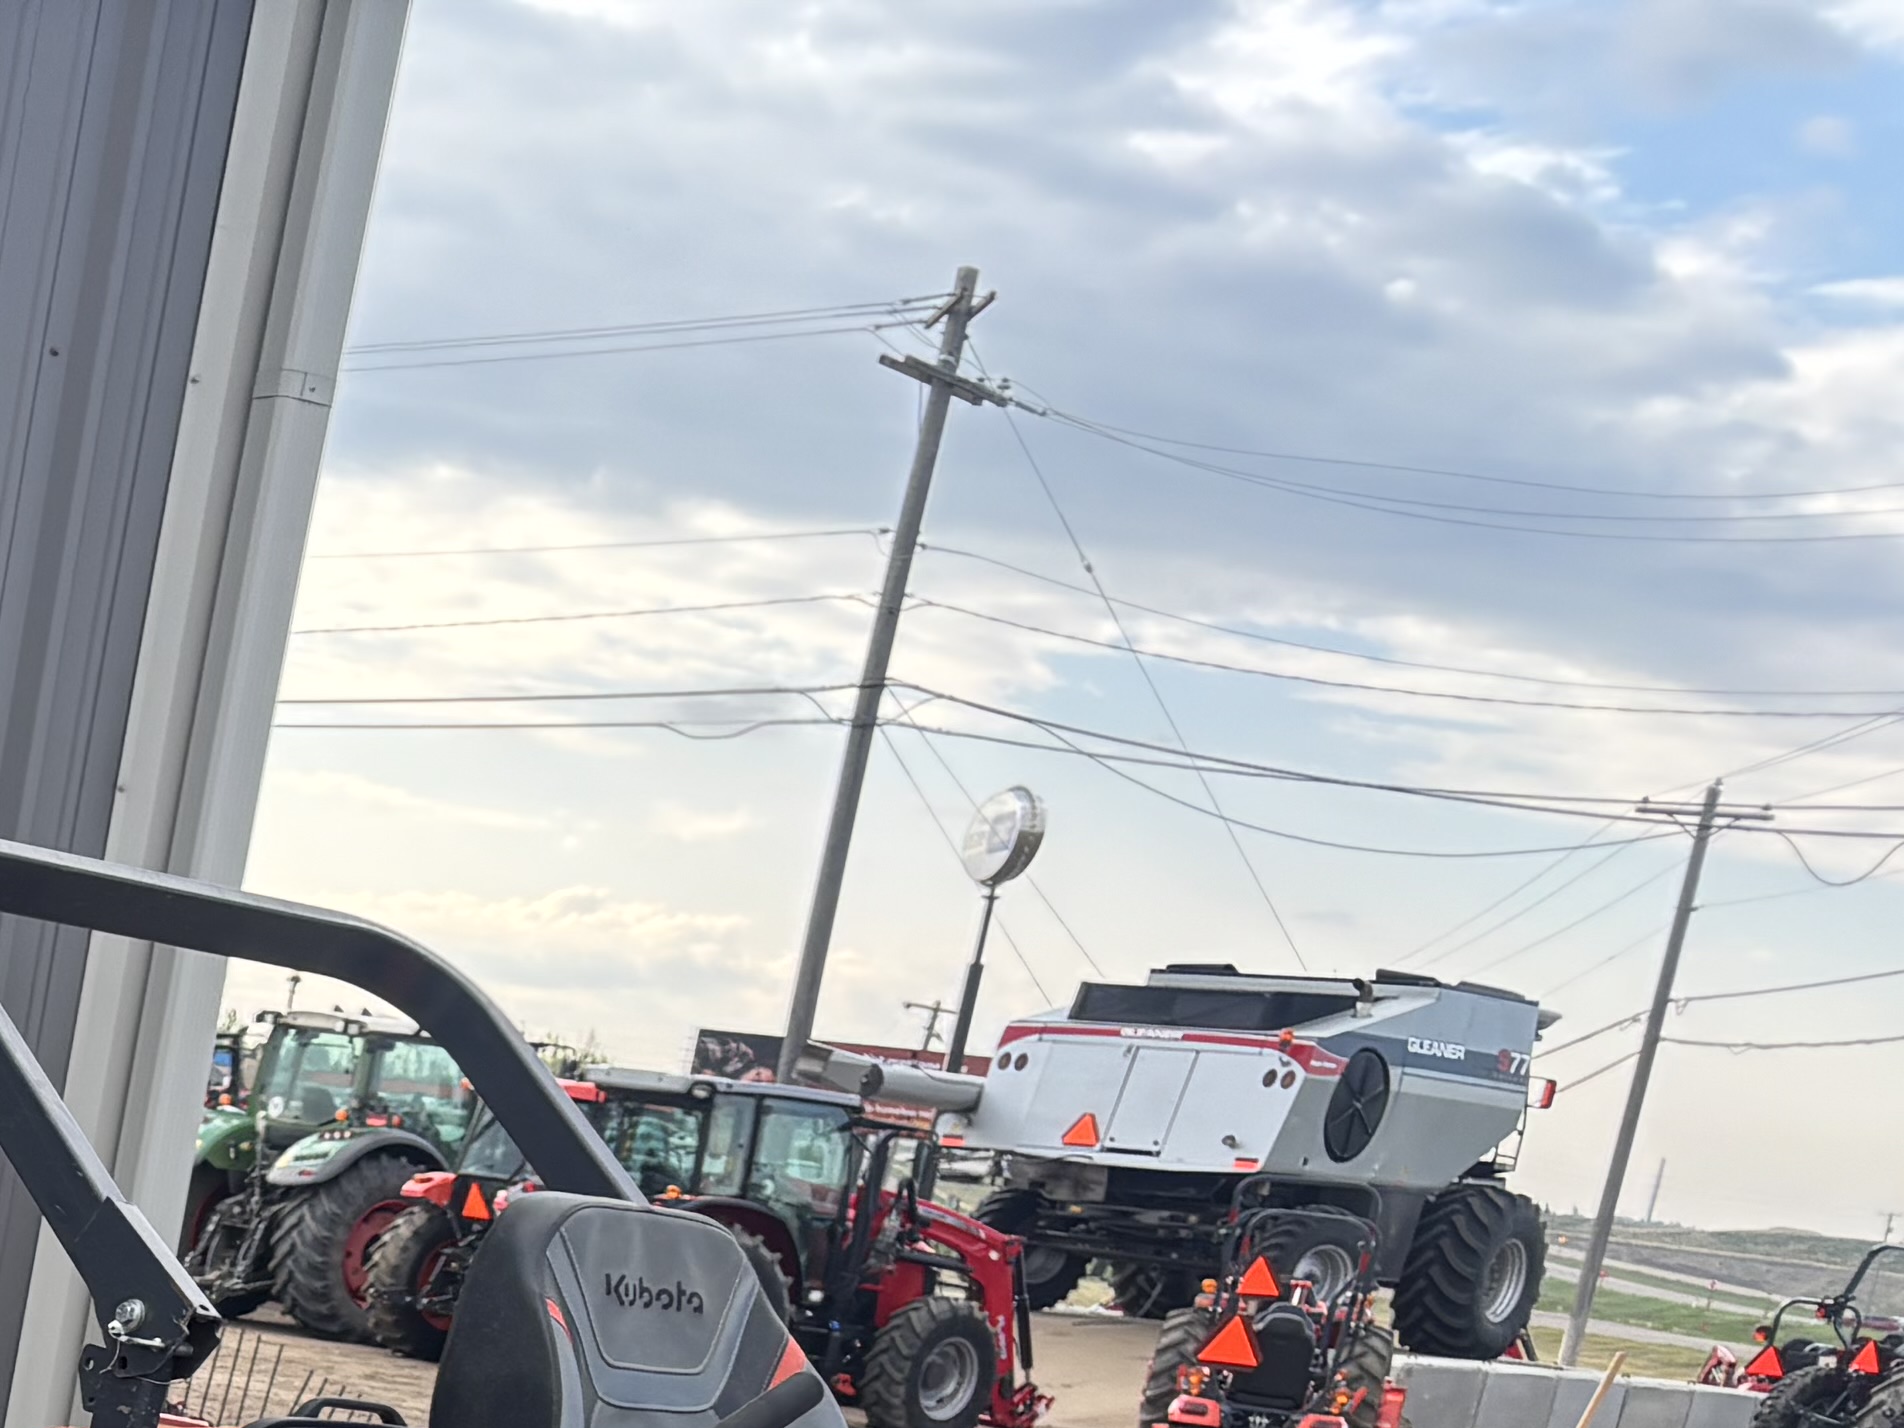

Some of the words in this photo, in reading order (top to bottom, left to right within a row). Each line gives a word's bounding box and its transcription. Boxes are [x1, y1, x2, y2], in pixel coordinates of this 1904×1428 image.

[1407, 1037, 1467, 1061] GLEANER
[1497, 1048, 1532, 1076] S77
[605, 1273, 704, 1314] Kubota
